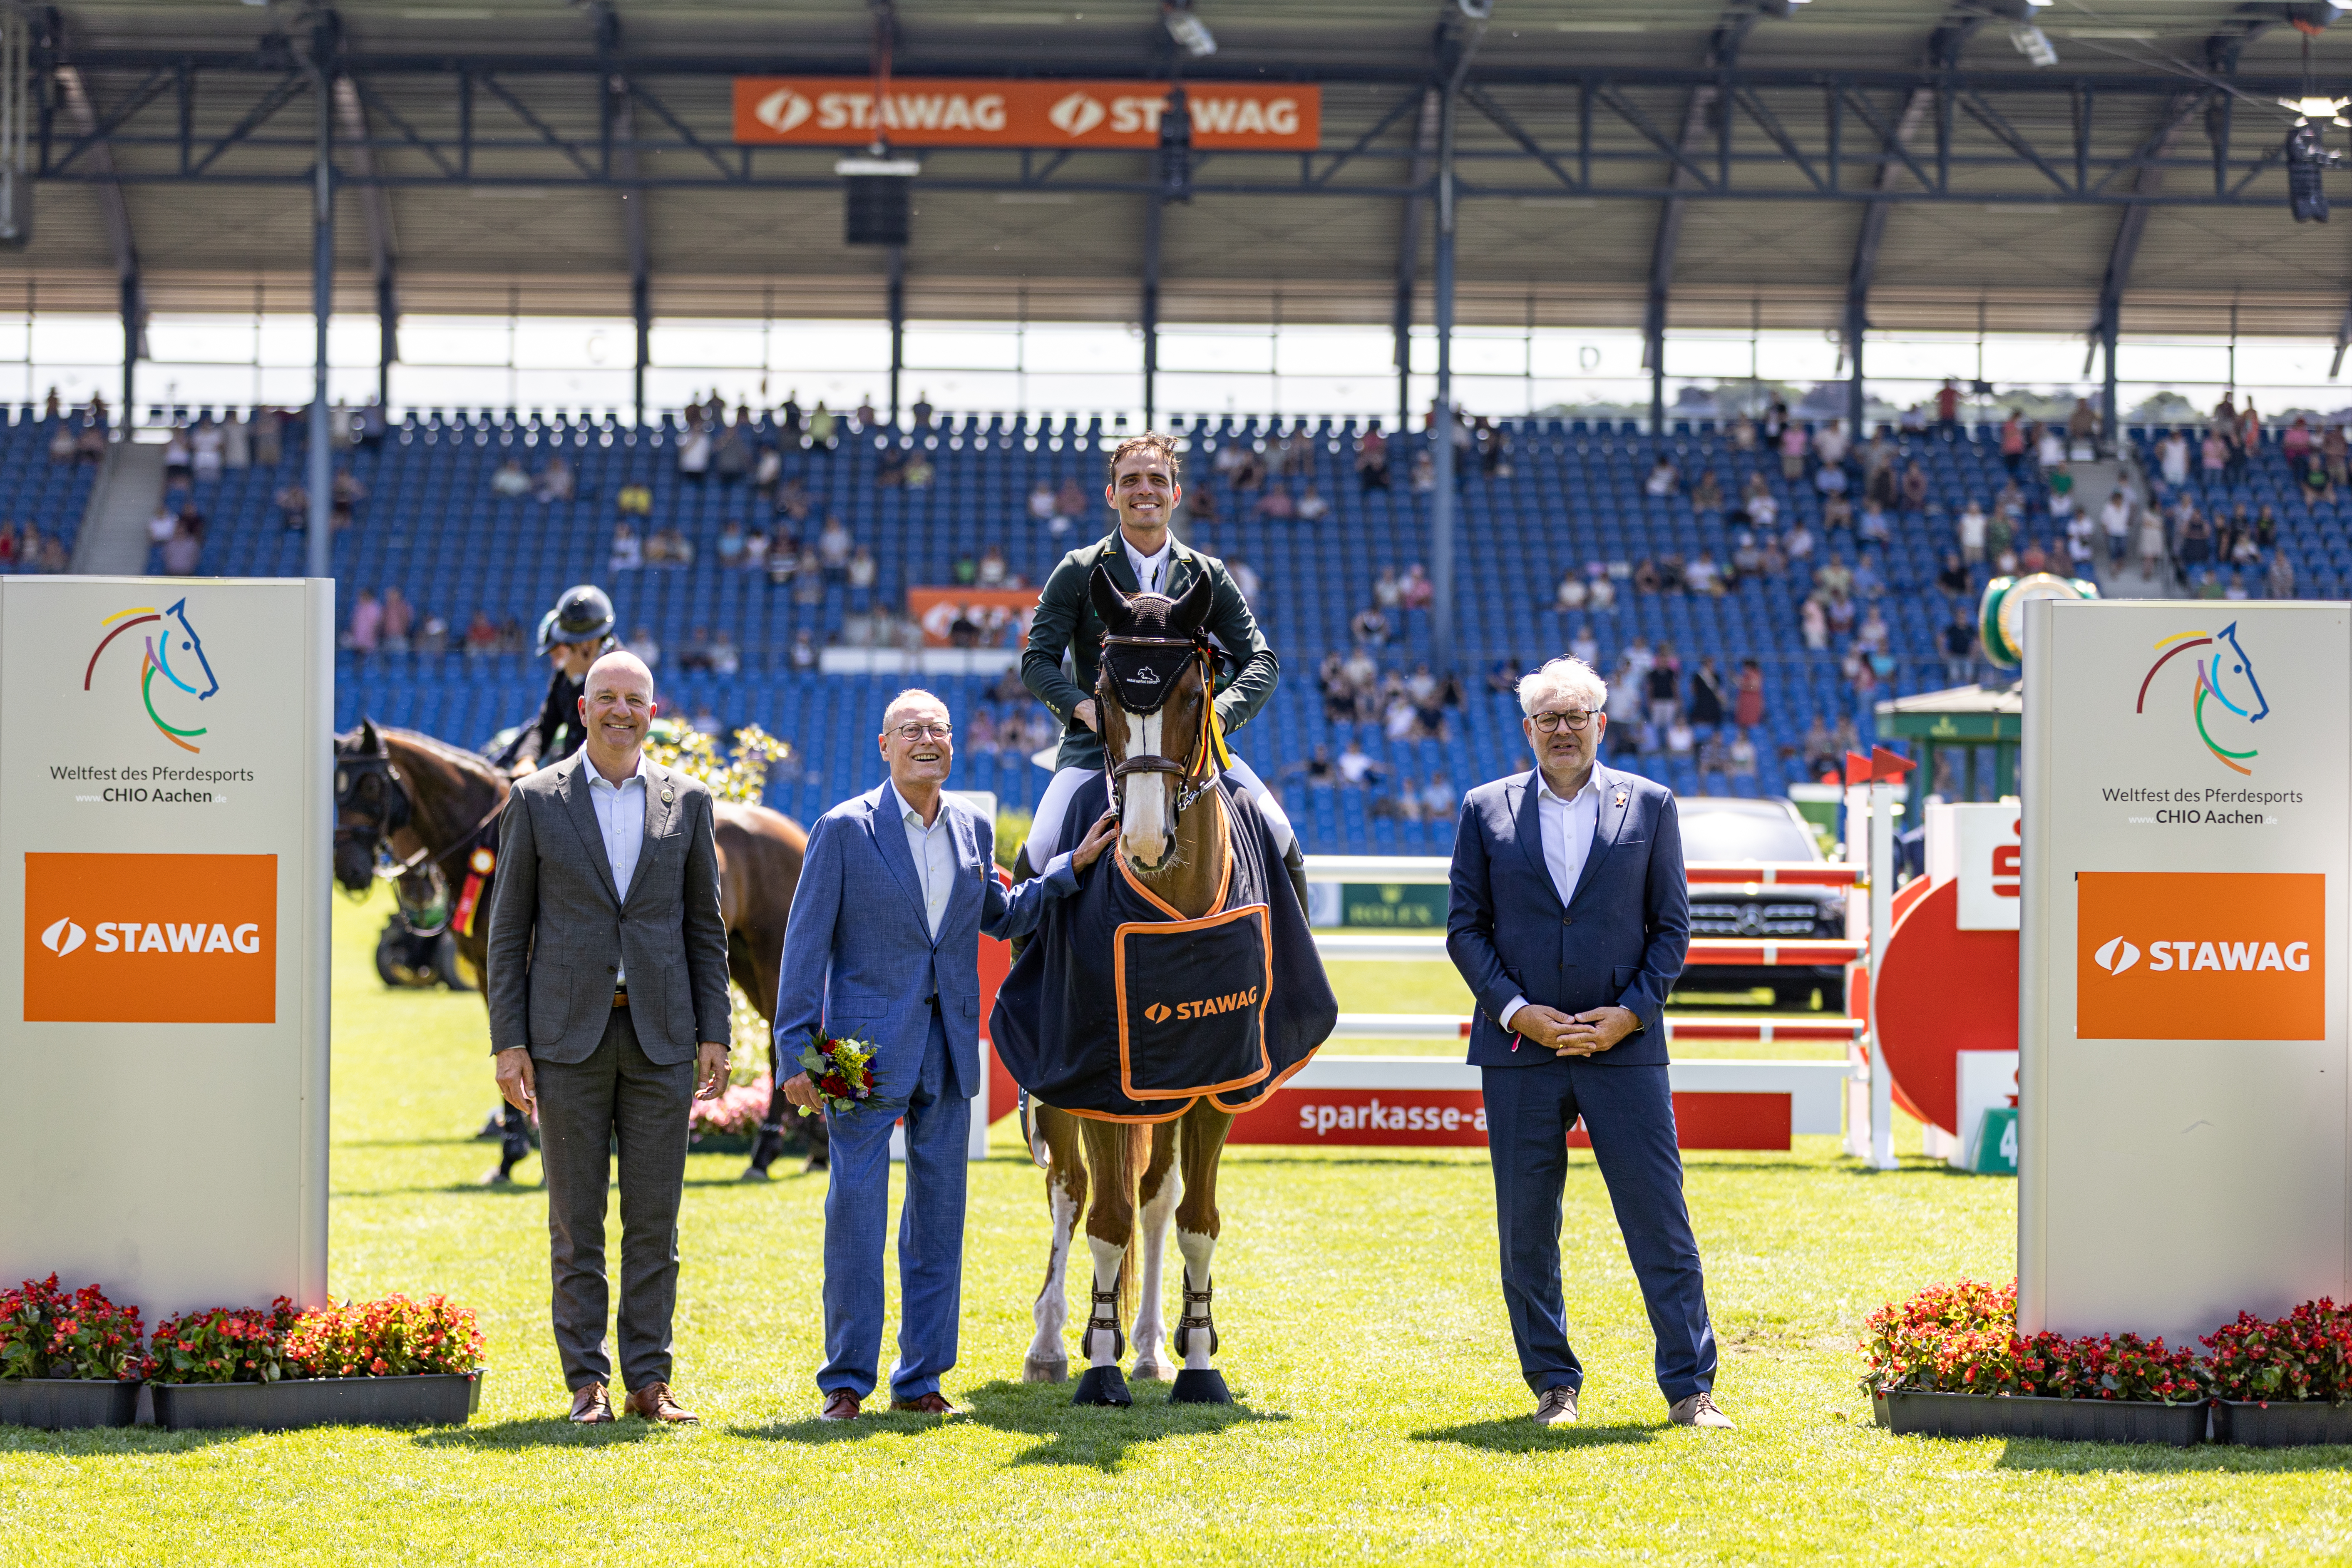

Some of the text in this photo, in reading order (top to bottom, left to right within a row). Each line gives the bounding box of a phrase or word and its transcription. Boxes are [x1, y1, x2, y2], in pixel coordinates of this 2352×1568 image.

[817, 94, 1006, 131] STAWAG
[1111, 98, 1299, 135] STWAG
[50, 766, 254, 784] Weltfest des Pferdesports
[2102, 788, 2303, 805] Weltfest des Pferdesports
[95, 922, 260, 954] STAWAG
[2149, 941, 2310, 972] STAWAG
[1177, 986, 1257, 1020] STAWAG
[1299, 1098, 1488, 1136] sparkasse-a
